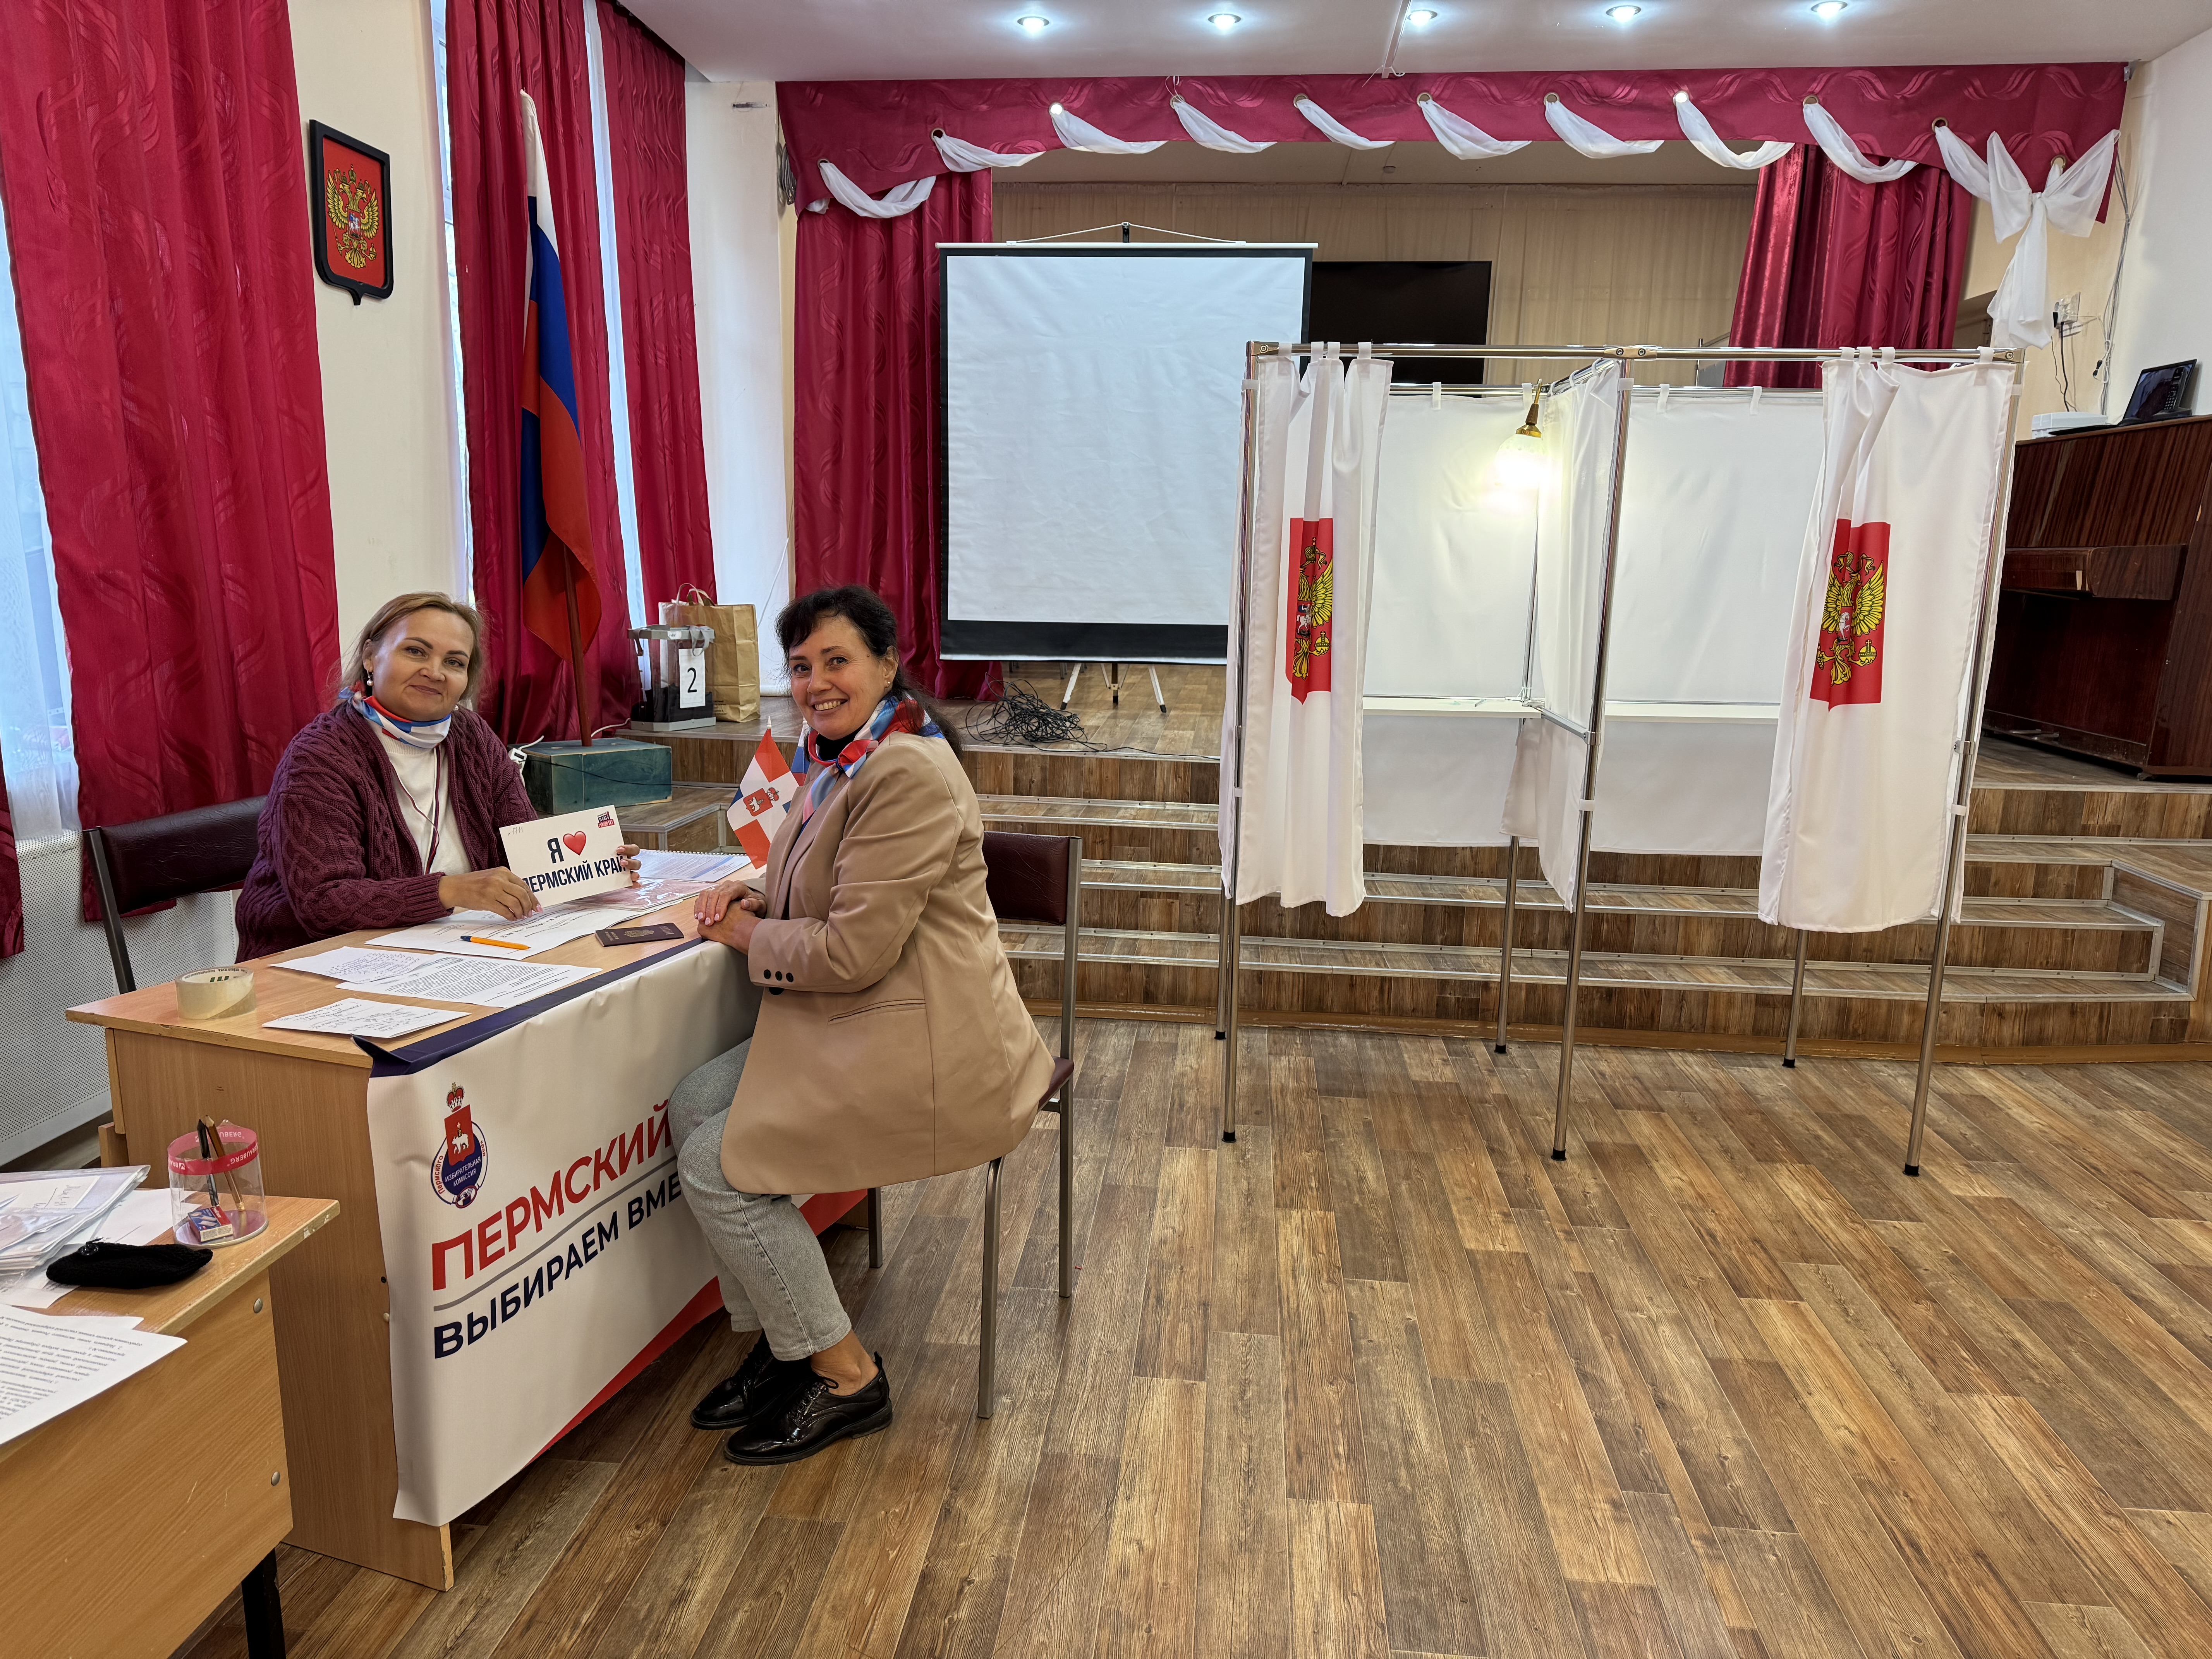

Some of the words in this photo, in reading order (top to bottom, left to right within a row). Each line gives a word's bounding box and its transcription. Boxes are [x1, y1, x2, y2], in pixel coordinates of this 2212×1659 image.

[687, 667, 697, 693] 2
[547, 838, 564, 863] Я
[594, 853, 626, 877] КРАЙ
[435, 1155, 445, 1194] Пермского
[445, 1156, 481, 1182] ИЗБИРАТЕЛЬНАЯ
[453, 1168, 476, 1187] КОМИССИЯ
[432, 1099, 671, 1290] ПЕРМСКИЙ
[434, 1211, 618, 1359] ВЫБИРАЕМ
[628, 1171, 681, 1230] ВМЕ
